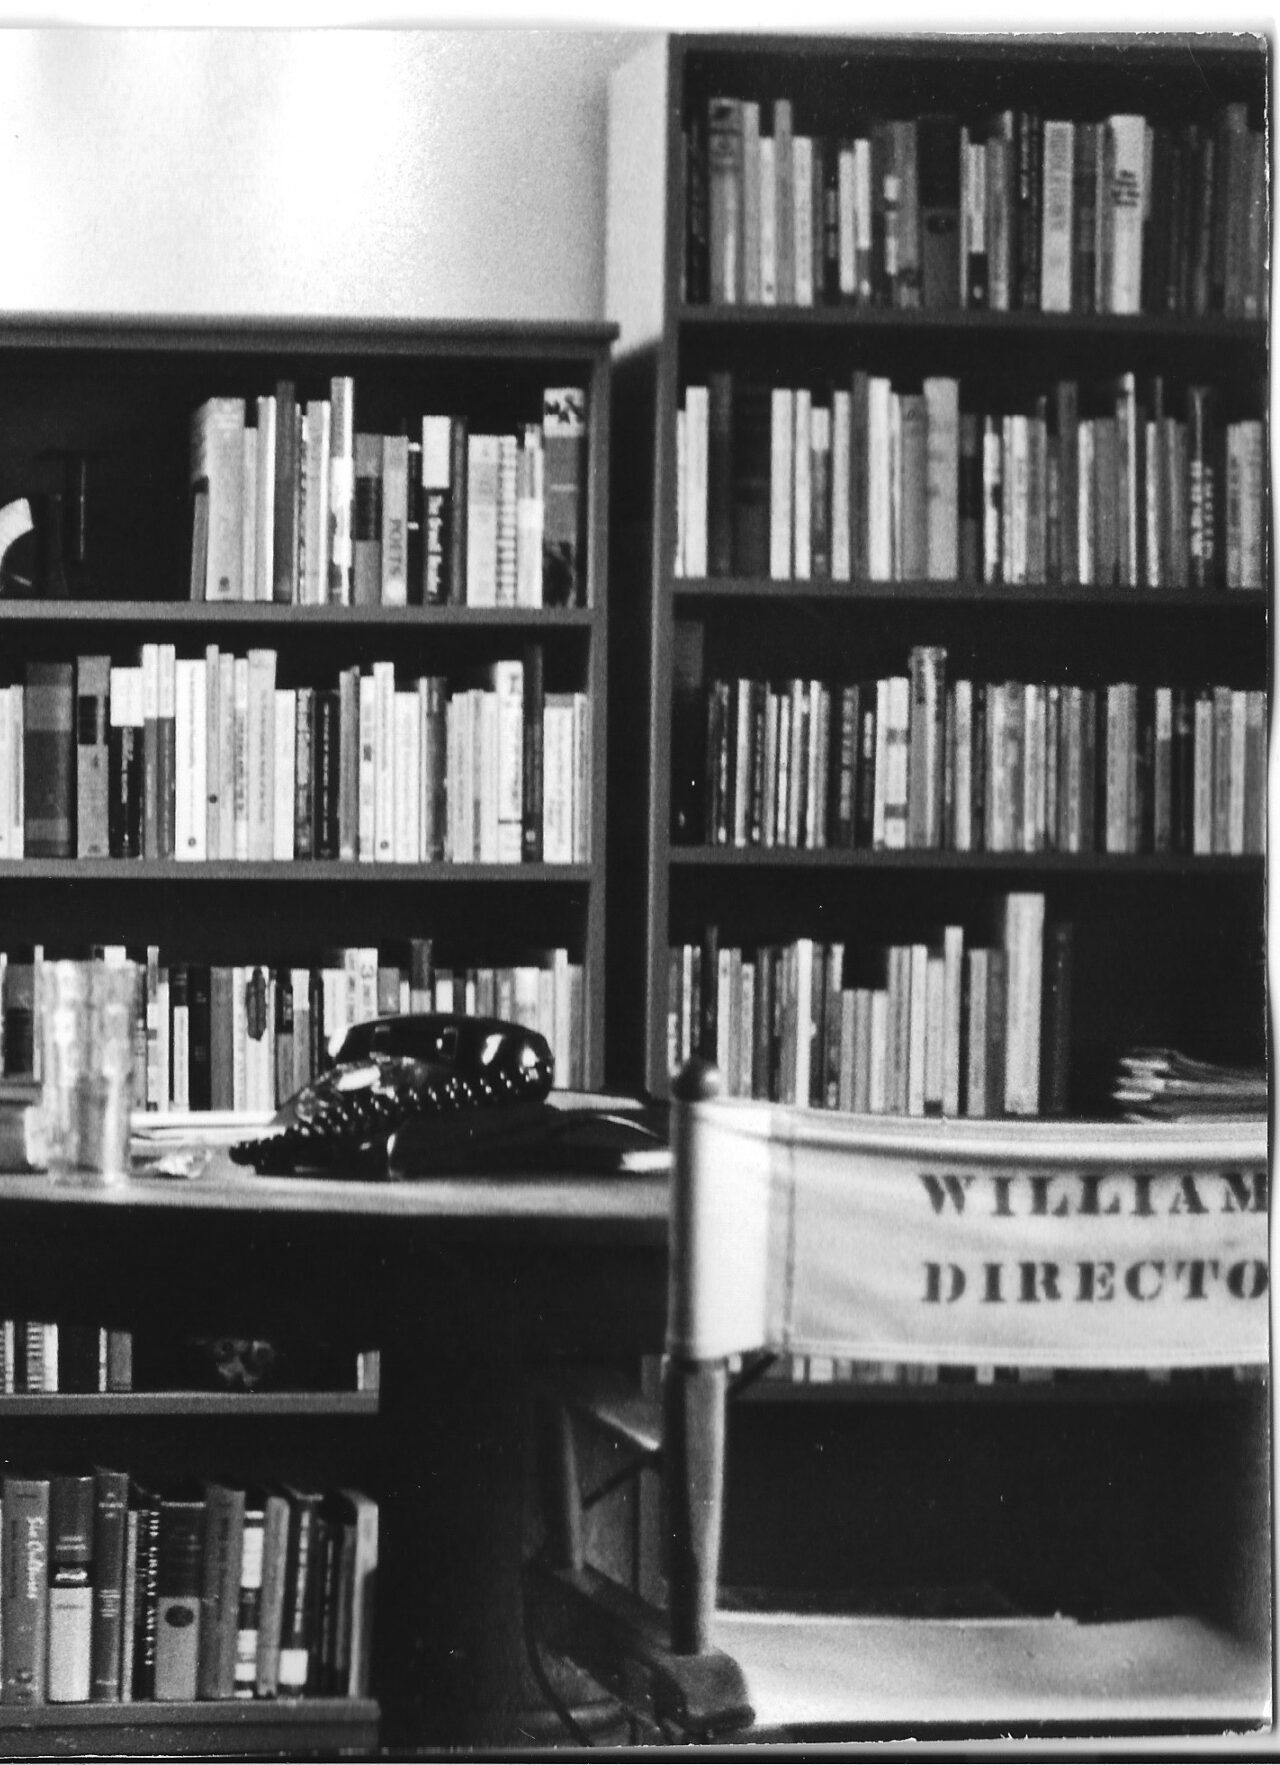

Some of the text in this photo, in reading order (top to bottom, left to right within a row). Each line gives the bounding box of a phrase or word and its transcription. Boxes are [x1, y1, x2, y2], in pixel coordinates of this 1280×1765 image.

[389, 518, 404, 576] POETS
[920, 1173, 1268, 1217] WILLIAM
[921, 1258, 1268, 1303] DIRECTO
